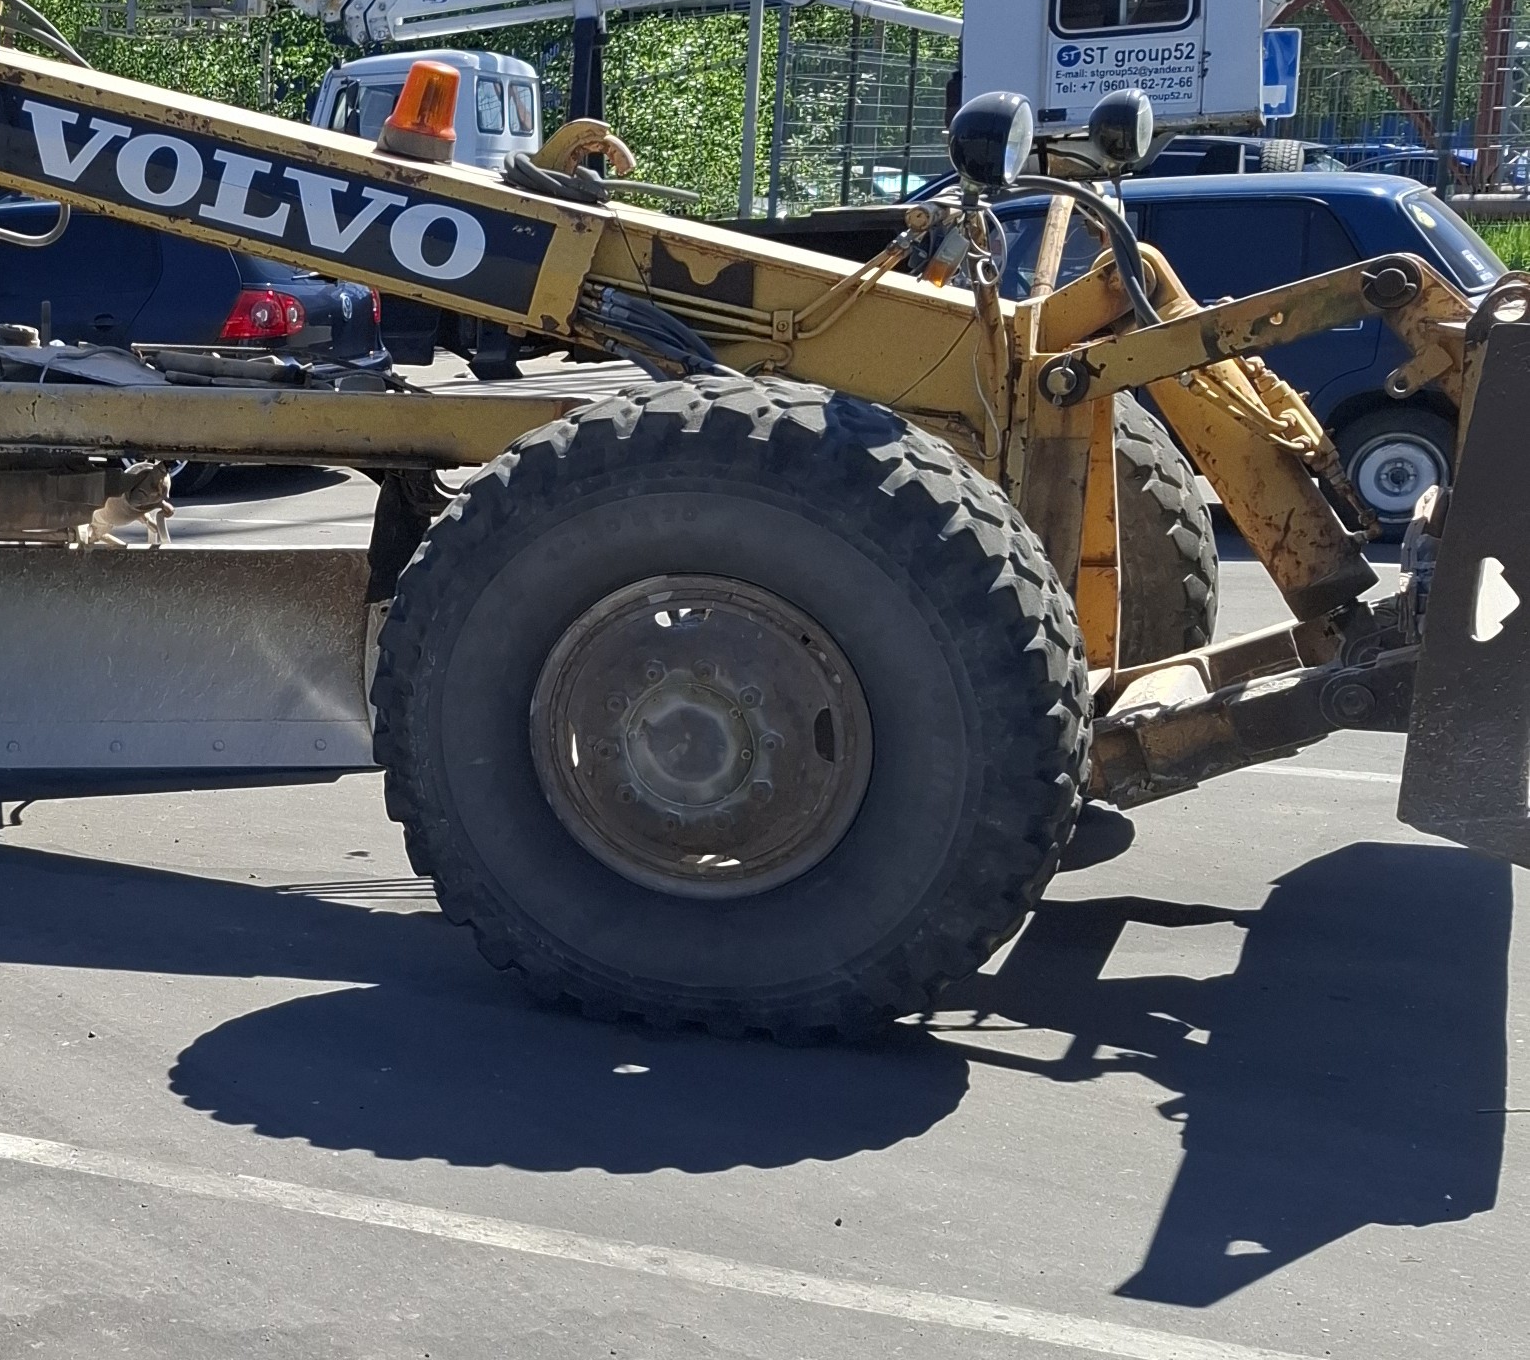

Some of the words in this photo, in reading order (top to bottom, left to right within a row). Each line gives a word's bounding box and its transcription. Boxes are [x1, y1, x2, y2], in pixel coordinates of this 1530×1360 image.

[1082, 46, 1109, 65] ST
[1115, 42, 1195, 67] group52
[1055, 70, 1088, 79] E-mail:
[1090, 64, 1195, 79] stgroup52@yandex.ru
[1056, 82, 1077, 94] Tel:
[1081, 81, 1095, 92] +7
[1134, 76, 1193, 90] 162-72-66
[1148, 91, 1193, 102] roup52.ru
[21, 99, 486, 280] VOLVO
